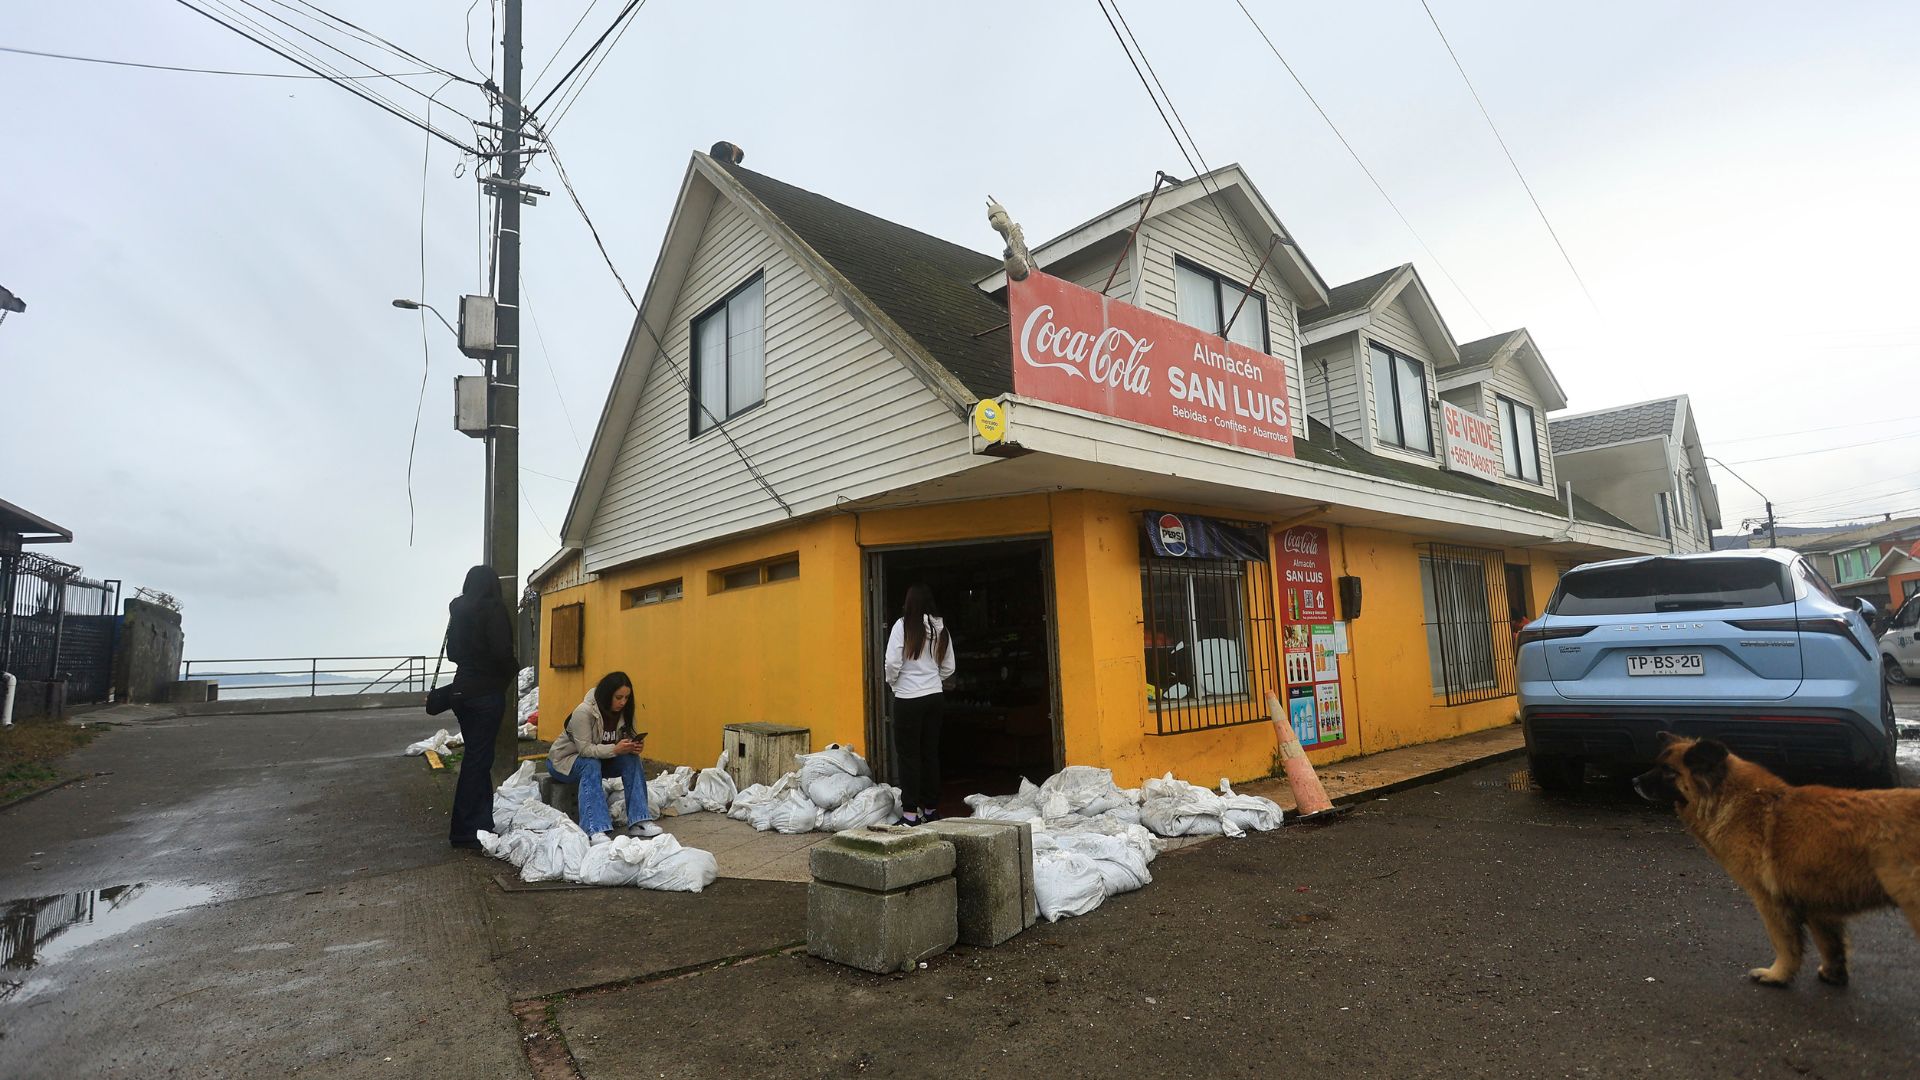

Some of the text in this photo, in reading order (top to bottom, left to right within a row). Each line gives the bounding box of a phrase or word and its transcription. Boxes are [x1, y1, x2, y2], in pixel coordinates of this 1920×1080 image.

[1193, 342, 1263, 383] Almacén
[1167, 366, 1288, 427] SAN LUIS
[1172, 405, 1289, 444] Bebidas Confites Abarrotes
[1445, 407, 1494, 451] SE VENDE
[1161, 529, 1185, 541] PEPSI
[1286, 569, 1324, 584] SAN LUIS
[1293, 559, 1316, 568] Almacén
[1614, 623, 1704, 631] JETOUR
